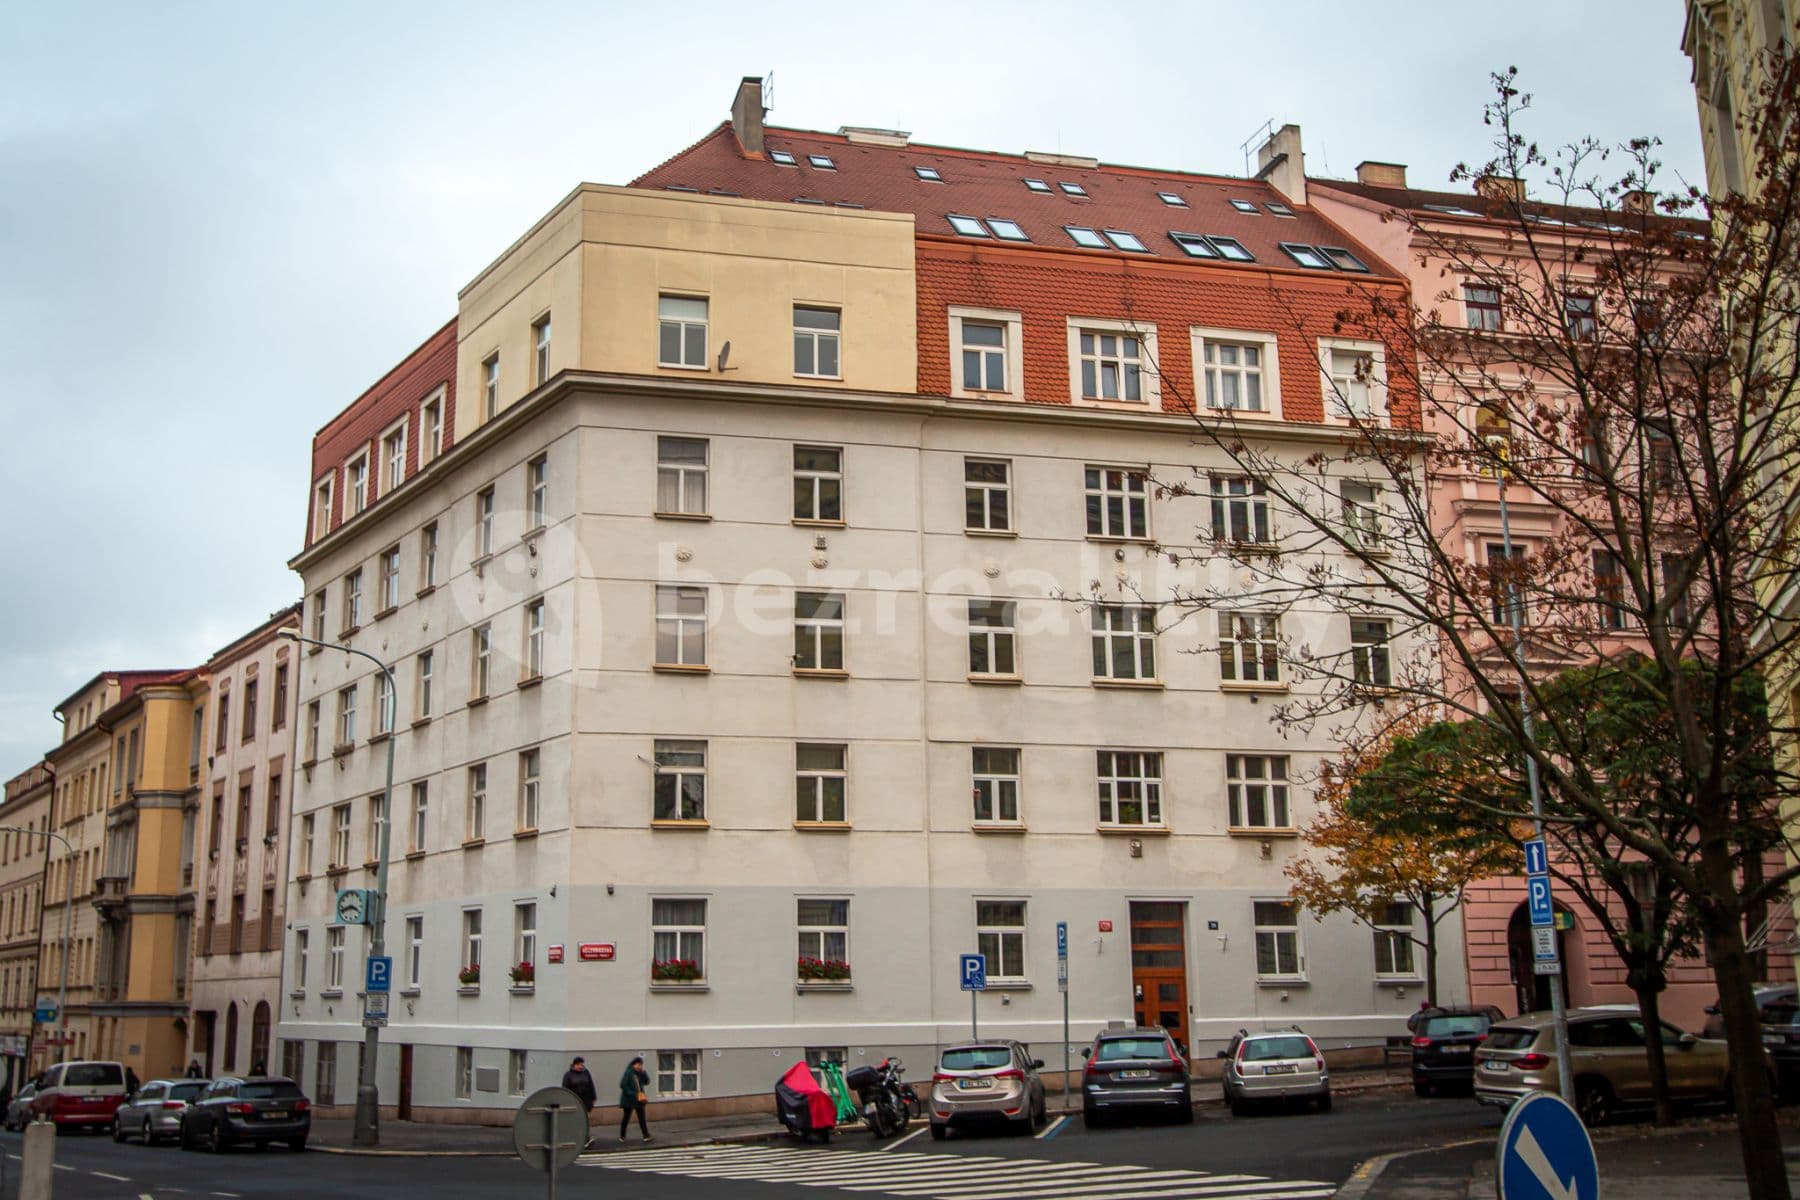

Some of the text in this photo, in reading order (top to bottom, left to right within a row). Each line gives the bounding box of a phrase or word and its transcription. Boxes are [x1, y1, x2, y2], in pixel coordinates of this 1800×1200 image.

[1533, 883, 1545, 909] P
[372, 962, 386, 981] P
[966, 959, 980, 979] P
